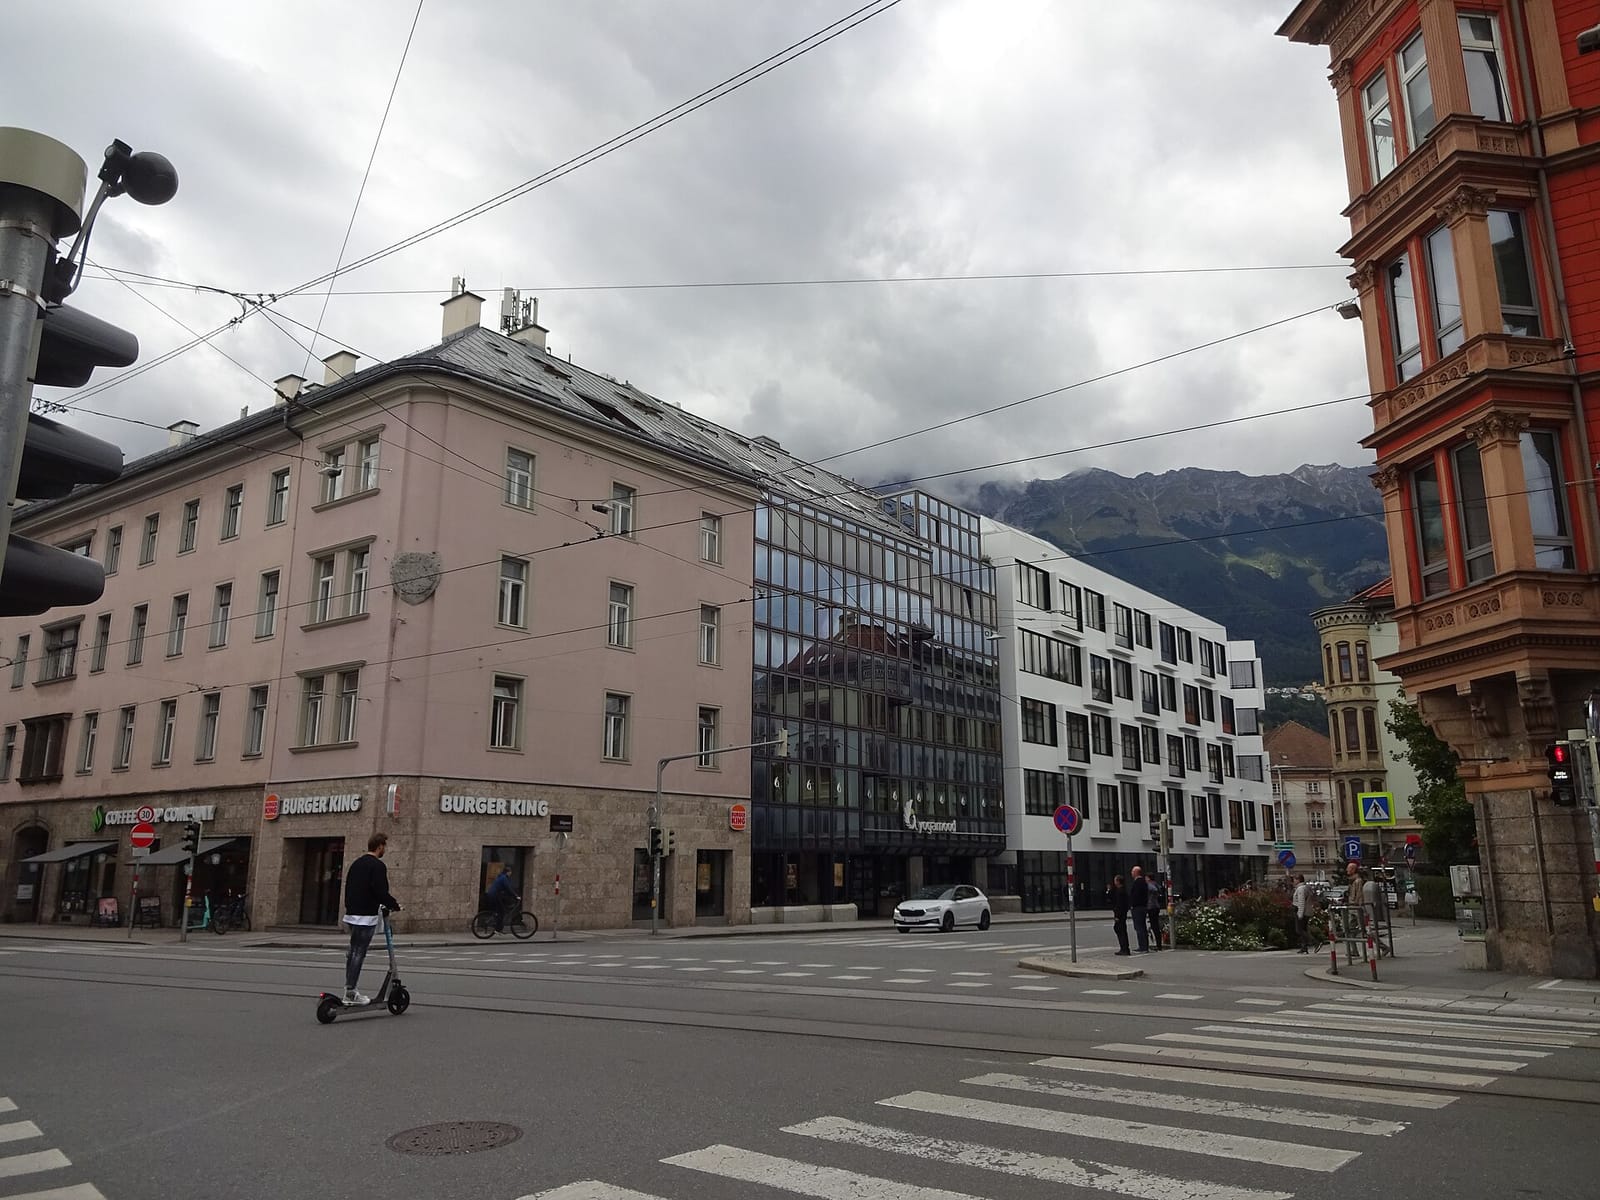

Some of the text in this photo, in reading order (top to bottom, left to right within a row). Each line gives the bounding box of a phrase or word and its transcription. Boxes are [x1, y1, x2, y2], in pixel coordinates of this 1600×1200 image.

[282, 795, 361, 814] BURGER KING
[441, 796, 548, 816] BURGER KING
[141, 810, 151, 819] 30
[732, 817, 746, 825] KING
[1349, 844, 1358, 855] P
